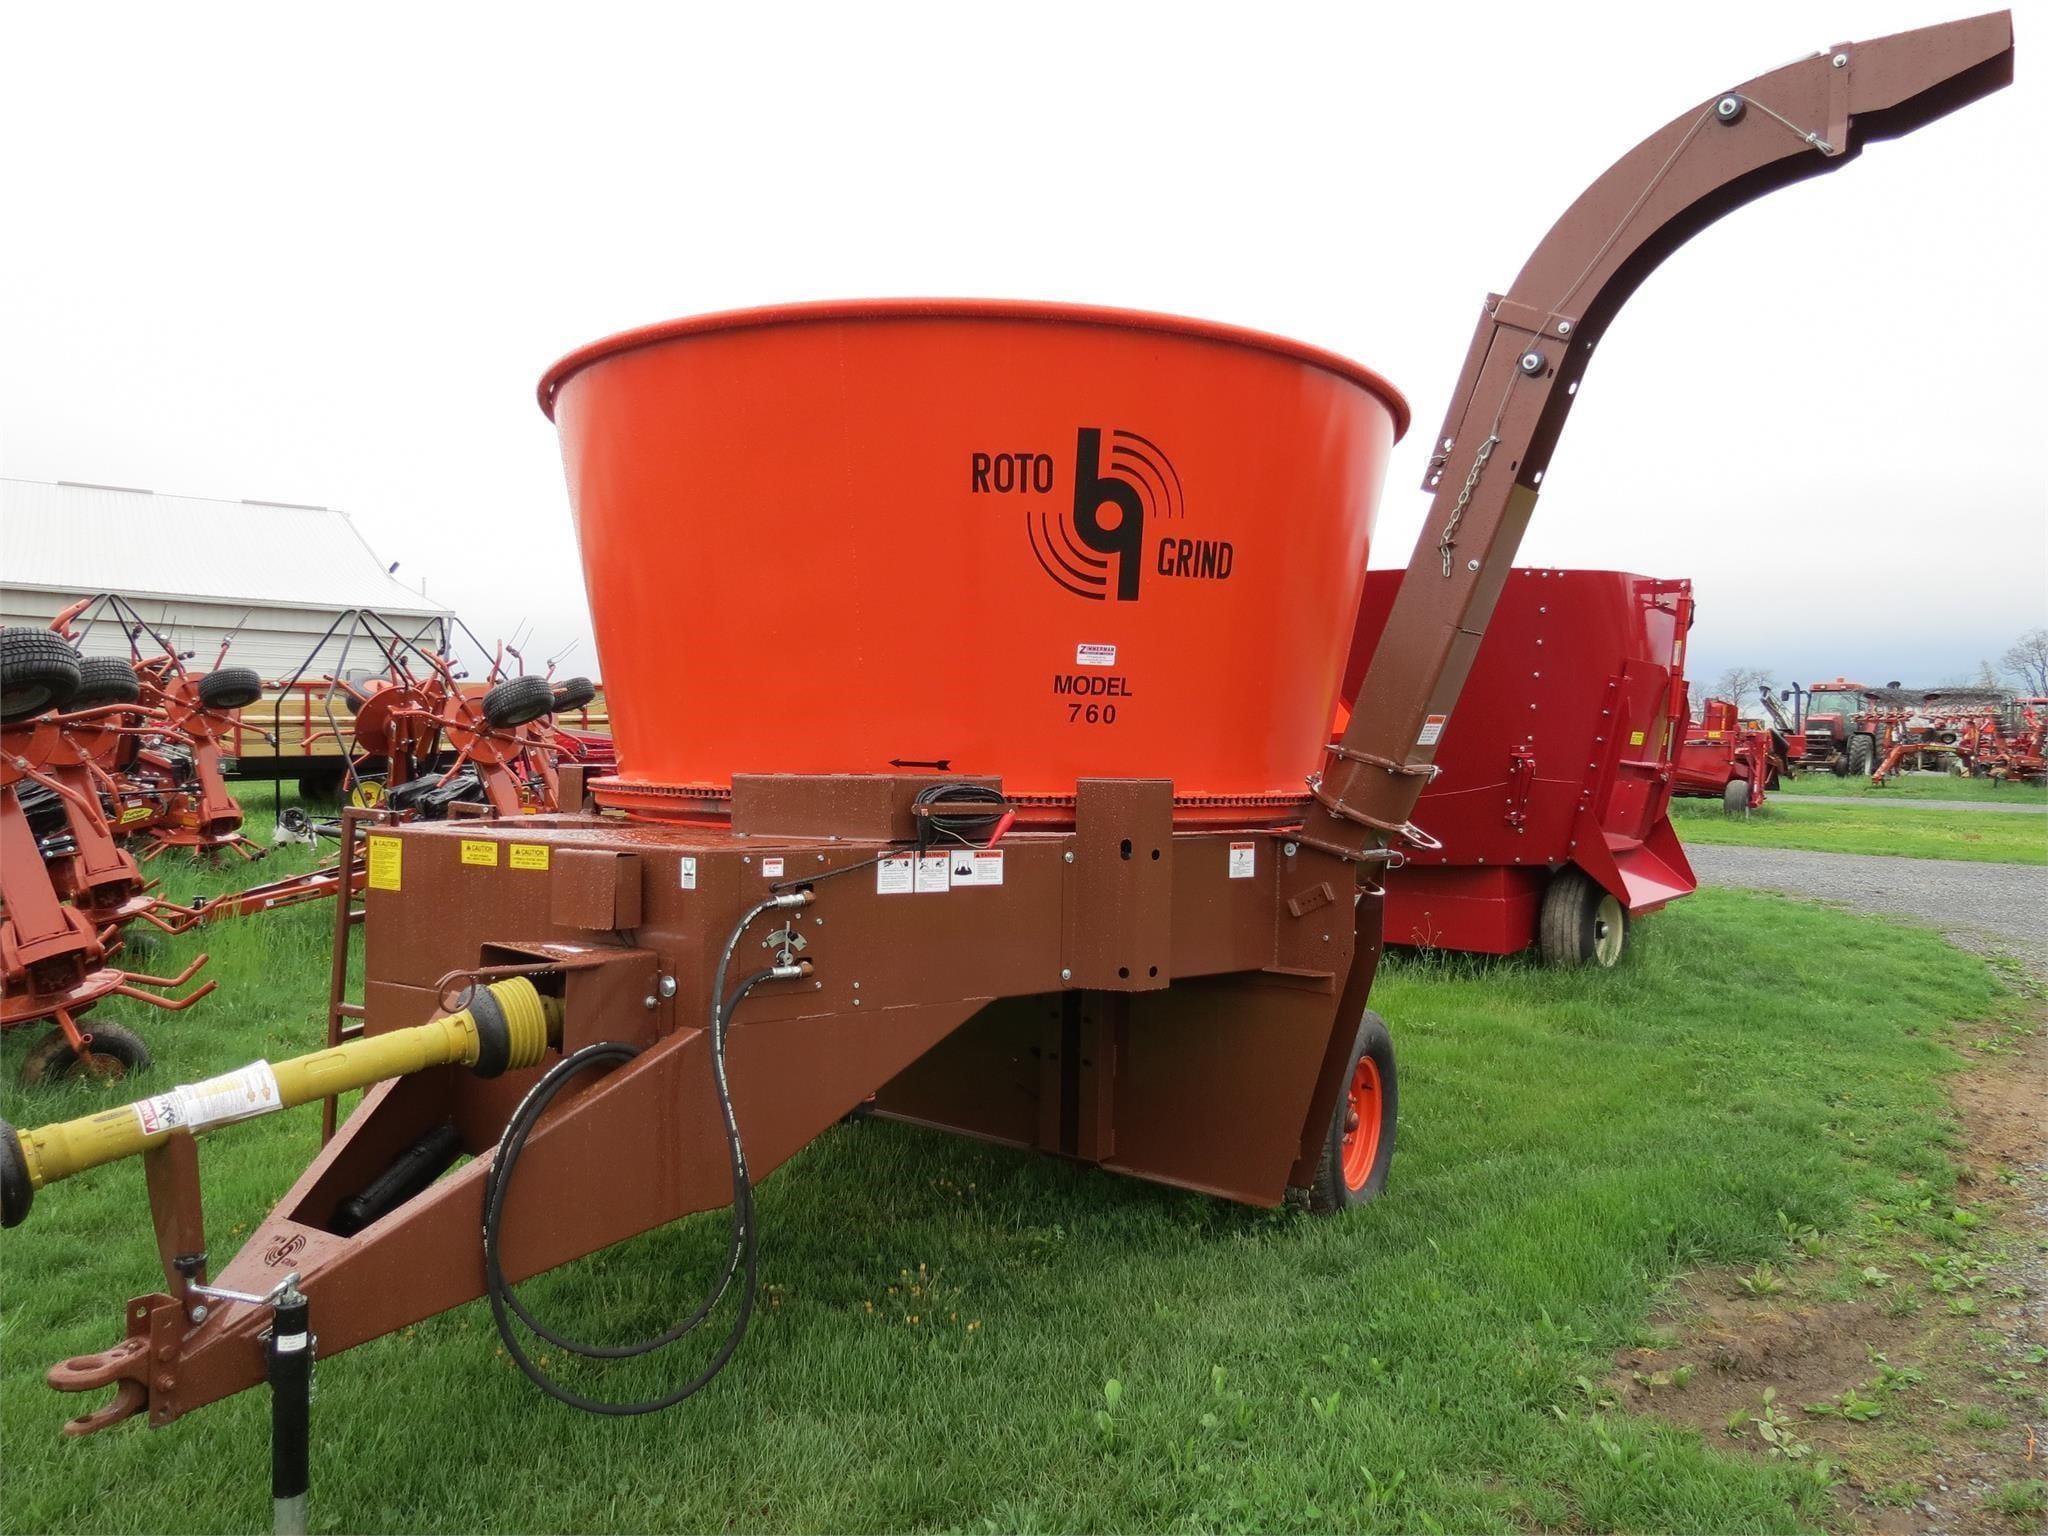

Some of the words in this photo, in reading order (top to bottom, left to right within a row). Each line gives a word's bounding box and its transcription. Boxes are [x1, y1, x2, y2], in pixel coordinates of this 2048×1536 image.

[972, 452, 1054, 494] ROTO
[1158, 537, 1233, 580] GRIND
[1053, 674, 1133, 697] MODEL
[1068, 703, 1116, 724] 760
[471, 844, 494, 852] CAUTION
[521, 848, 545, 856] CAUTION
